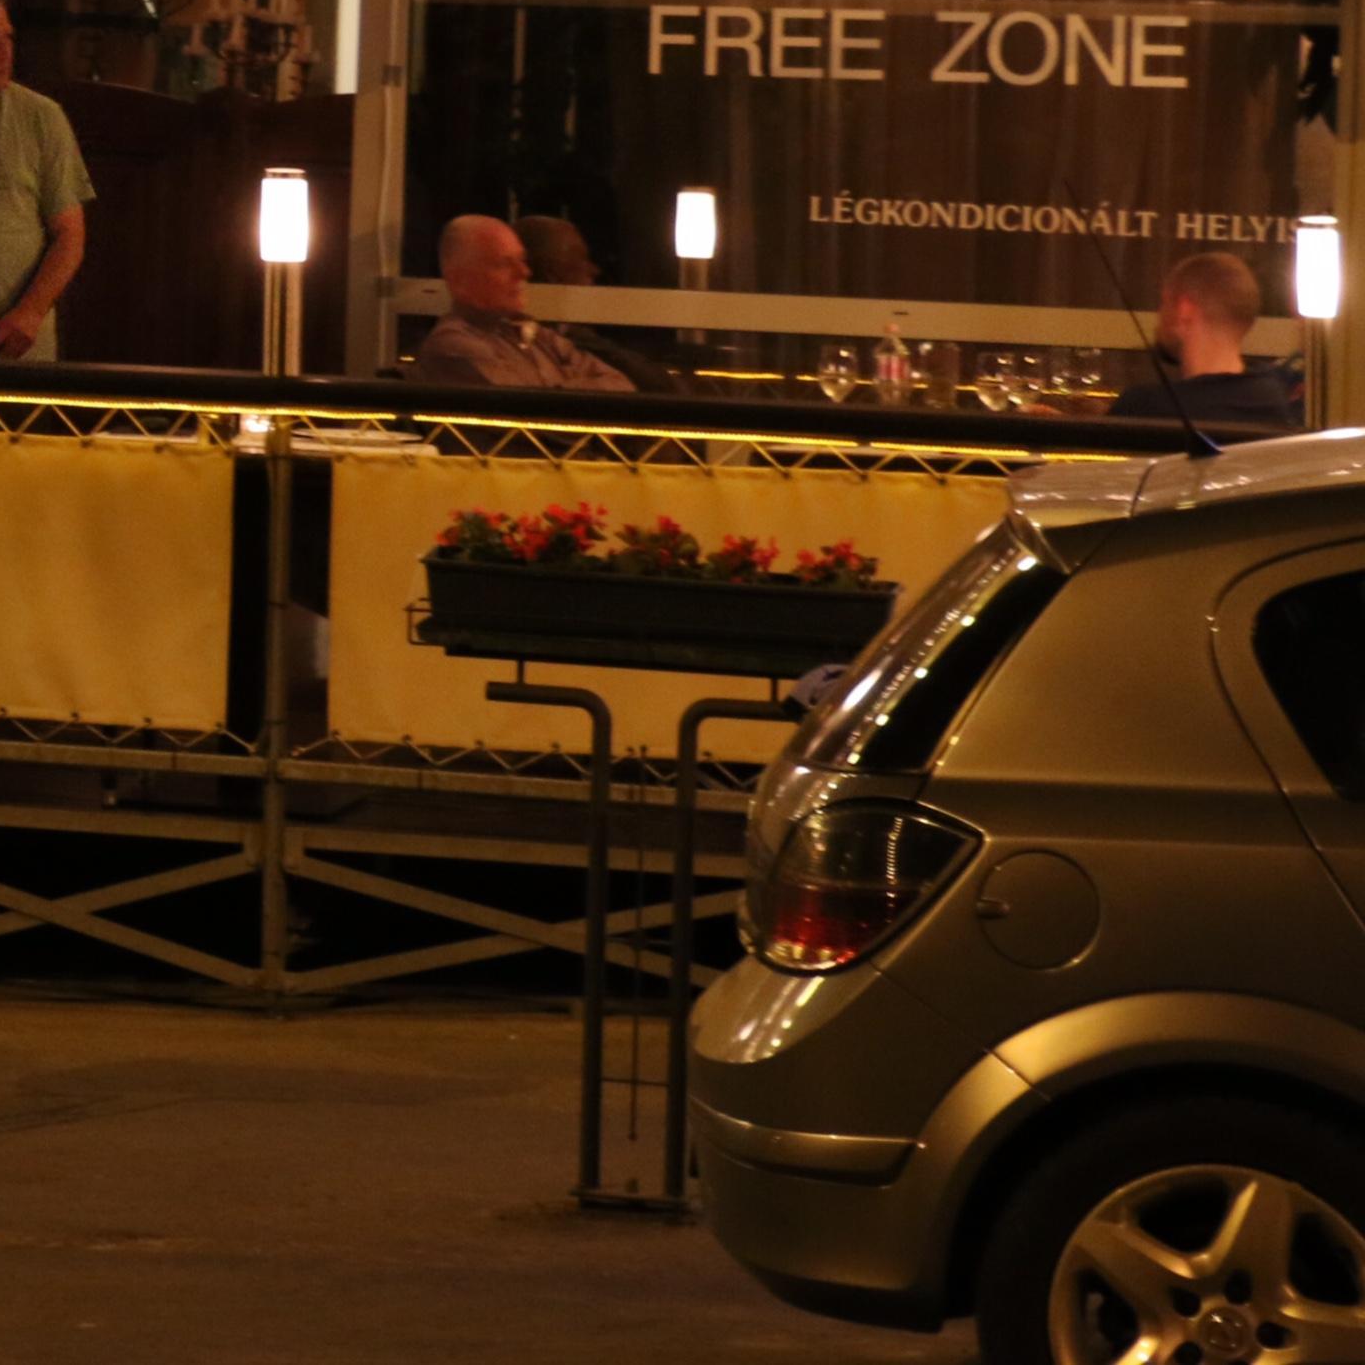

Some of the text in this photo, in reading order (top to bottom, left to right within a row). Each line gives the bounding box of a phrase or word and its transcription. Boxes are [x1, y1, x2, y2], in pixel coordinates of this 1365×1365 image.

[649, 5, 1189, 89] FREE ZONE
[809, 189, 1160, 238] LÉGKONDICIONÁLT
